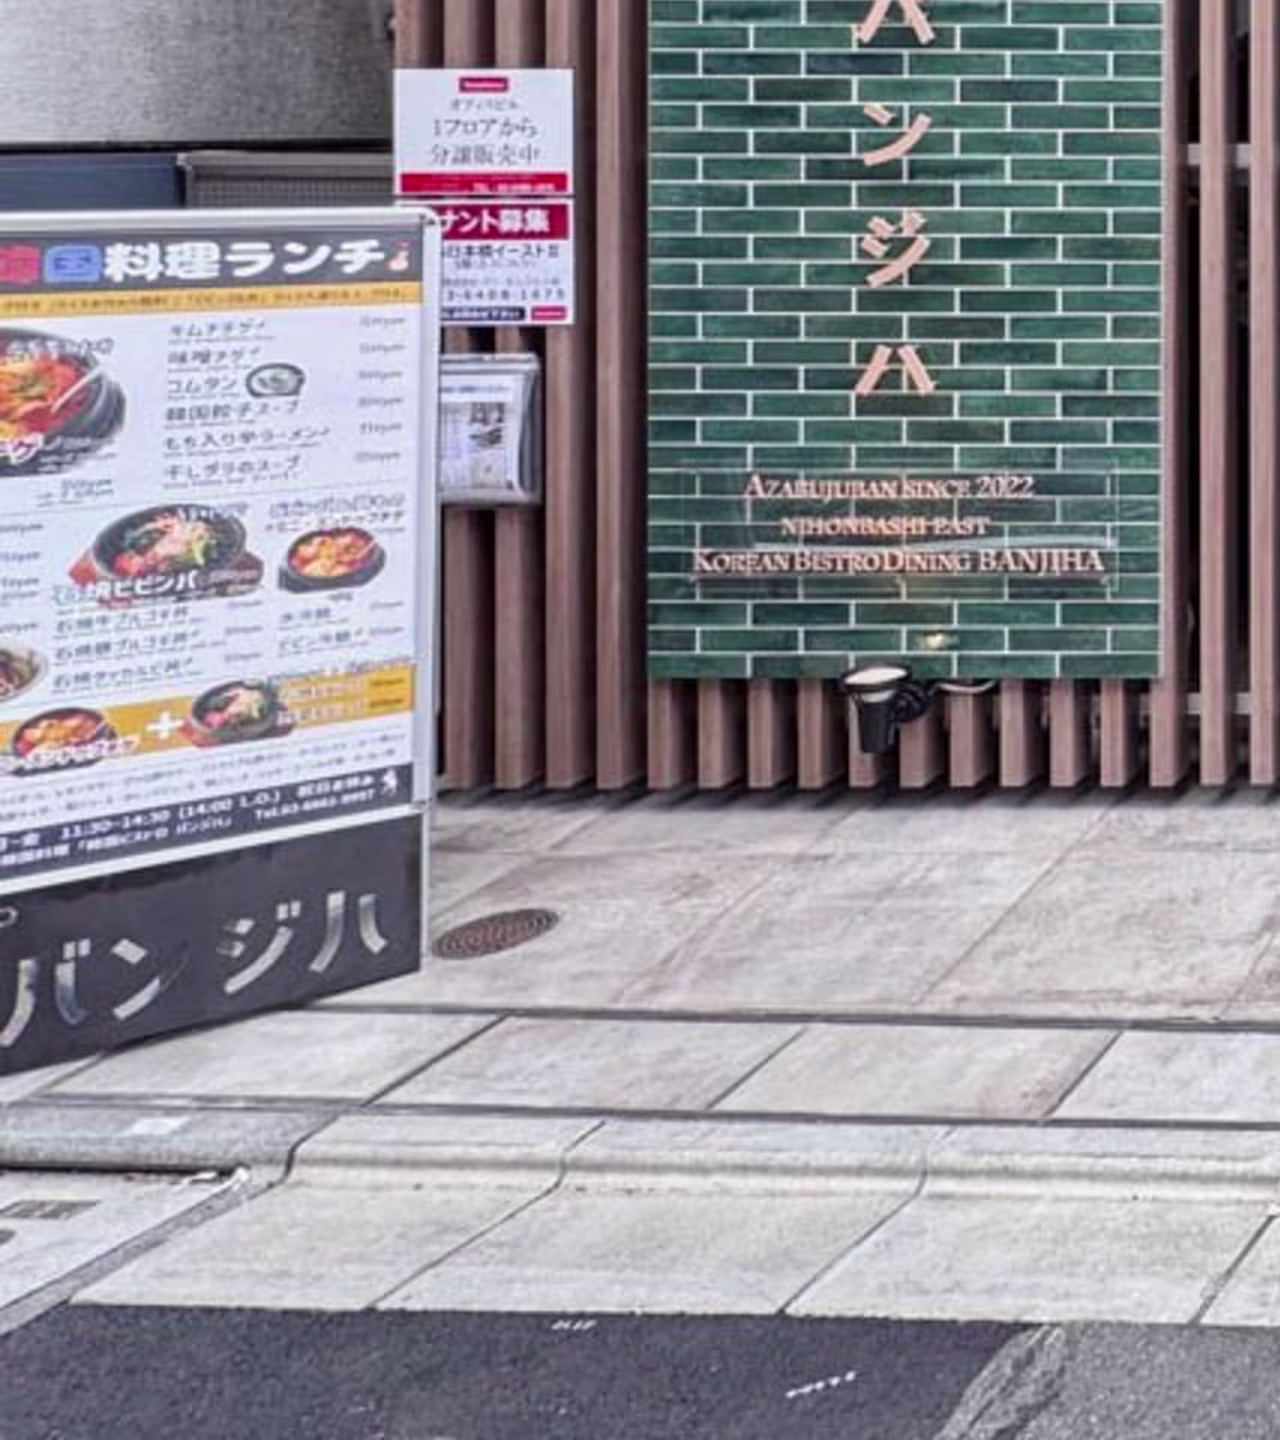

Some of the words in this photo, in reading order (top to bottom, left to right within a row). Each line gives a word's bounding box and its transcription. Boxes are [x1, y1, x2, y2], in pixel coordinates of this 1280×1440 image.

[438, 207, 550, 234] ナント募集
[977, 546, 1106, 576] BANJIHA
